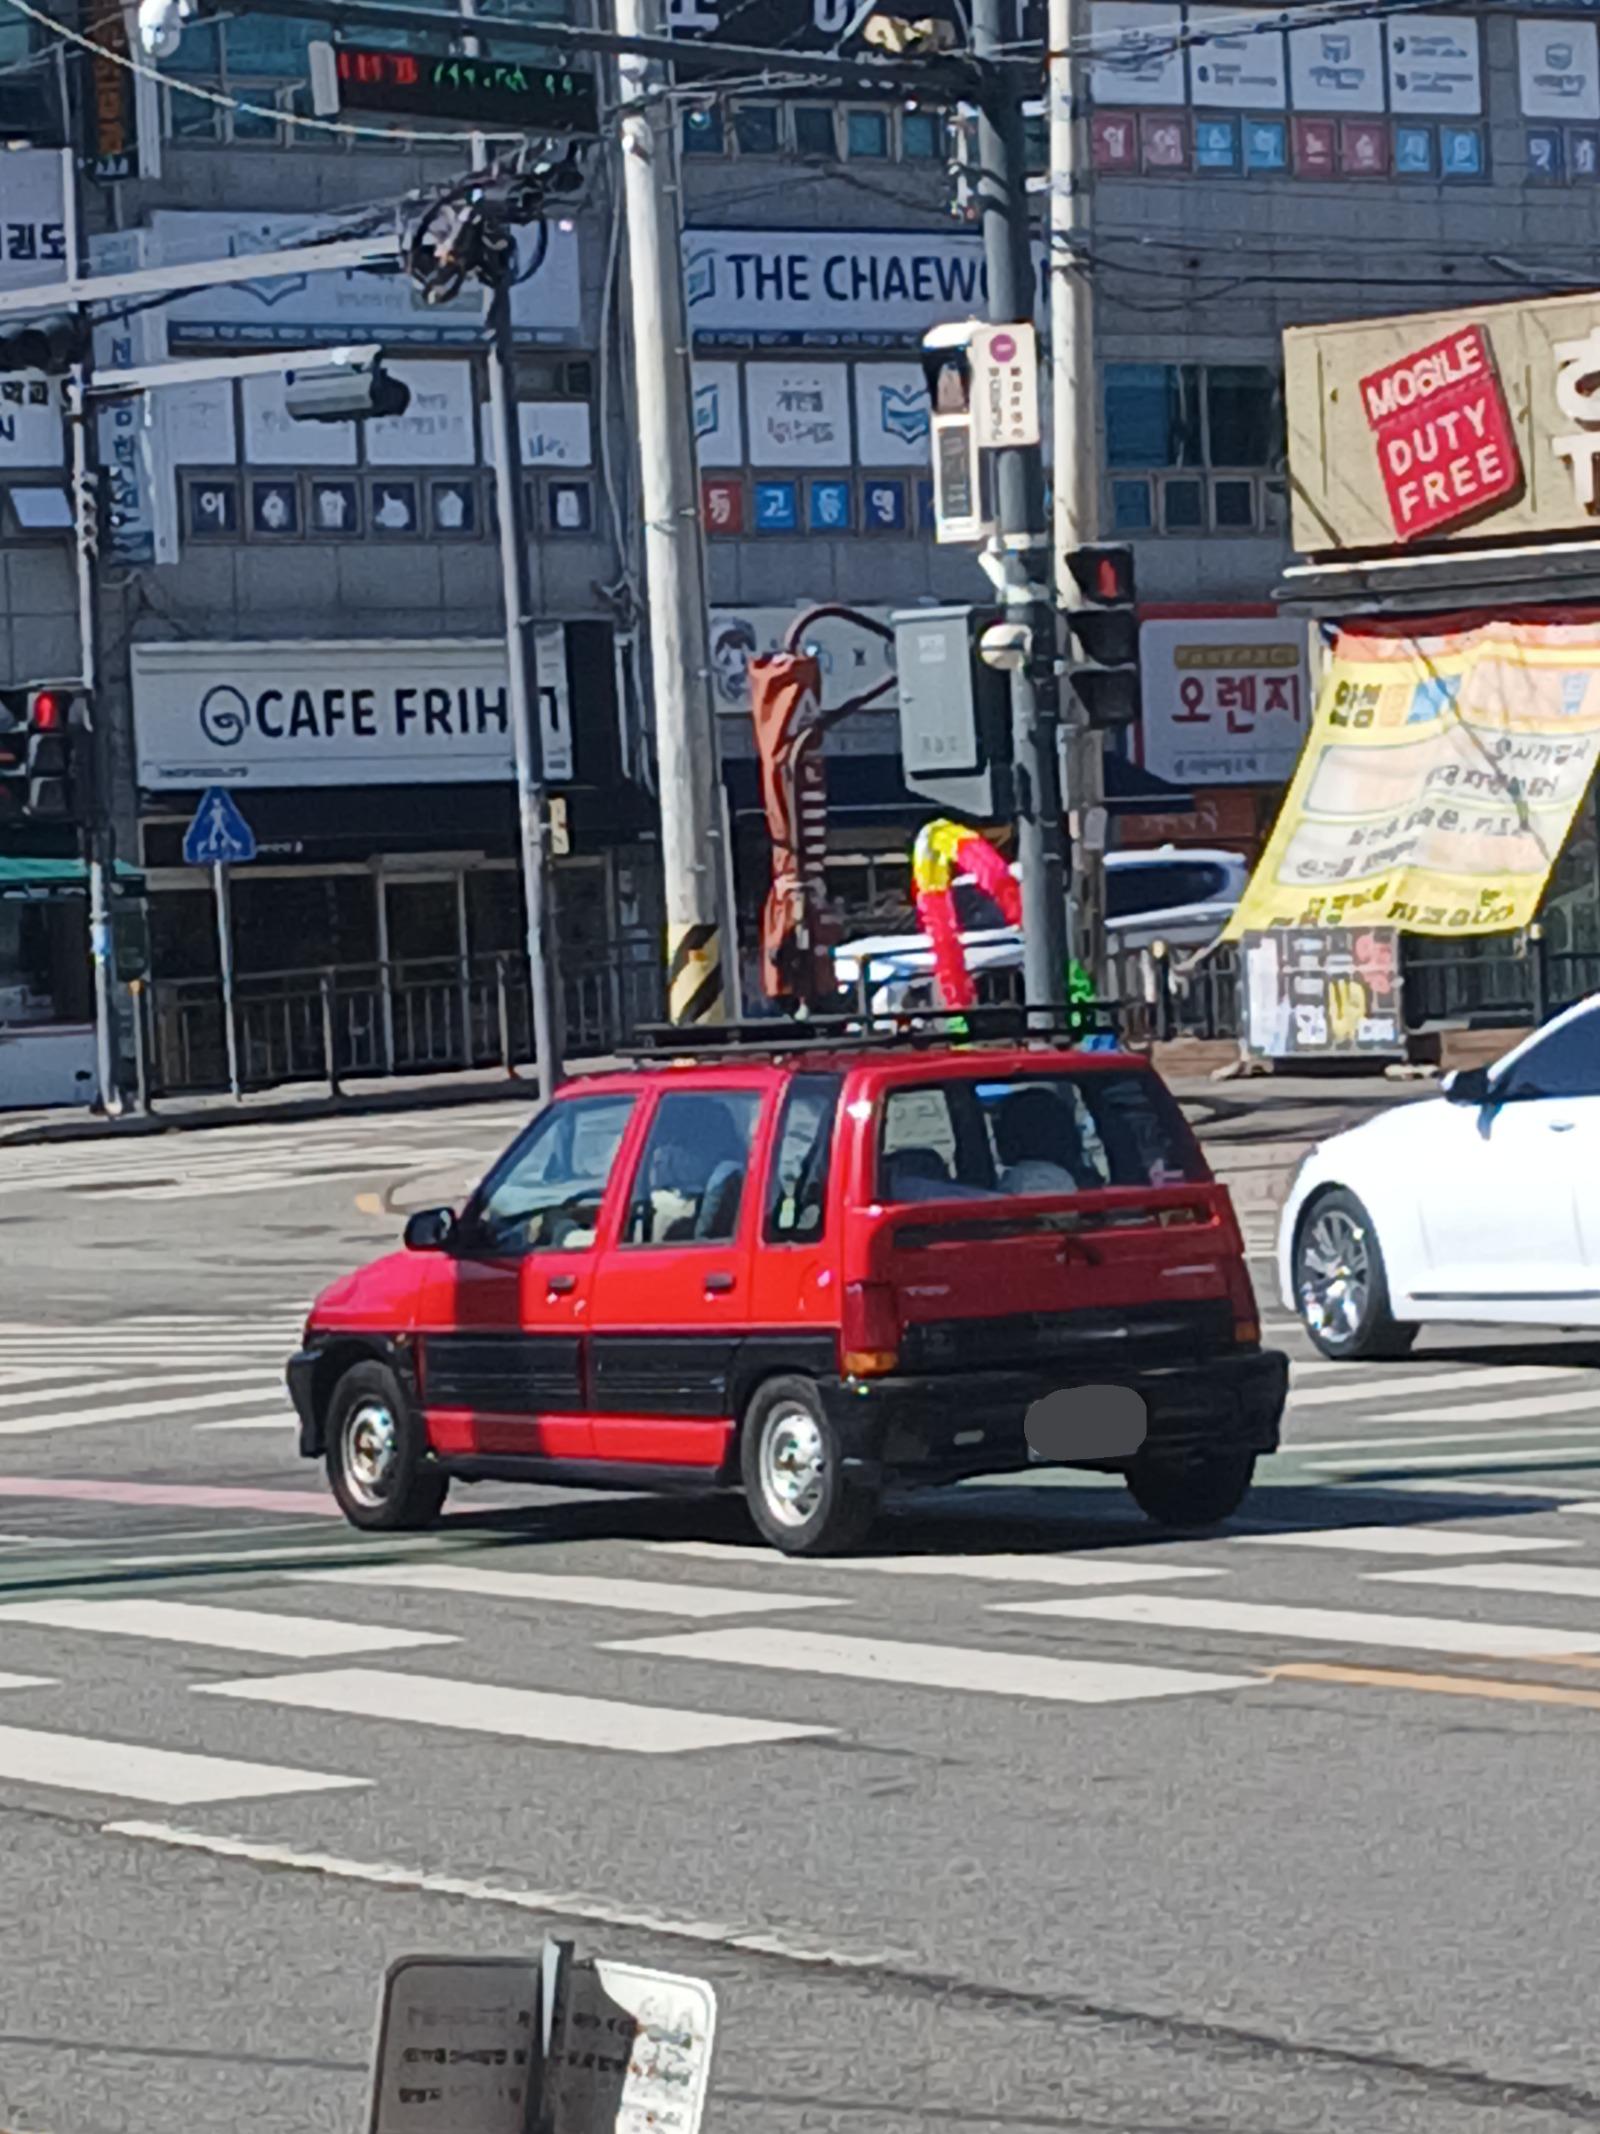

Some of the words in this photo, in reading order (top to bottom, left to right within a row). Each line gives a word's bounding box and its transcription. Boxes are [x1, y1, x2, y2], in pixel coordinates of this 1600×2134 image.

[726, 254, 811, 301] THE
[822, 254, 1049, 303] CHAEW
[1365, 334, 1483, 421] MOBILE
[1386, 397, 1487, 477] DUTY
[1397, 442, 1504, 523] FREE
[256, 688, 377, 738] CAFE
[1170, 673, 1301, 734] 오렌지
